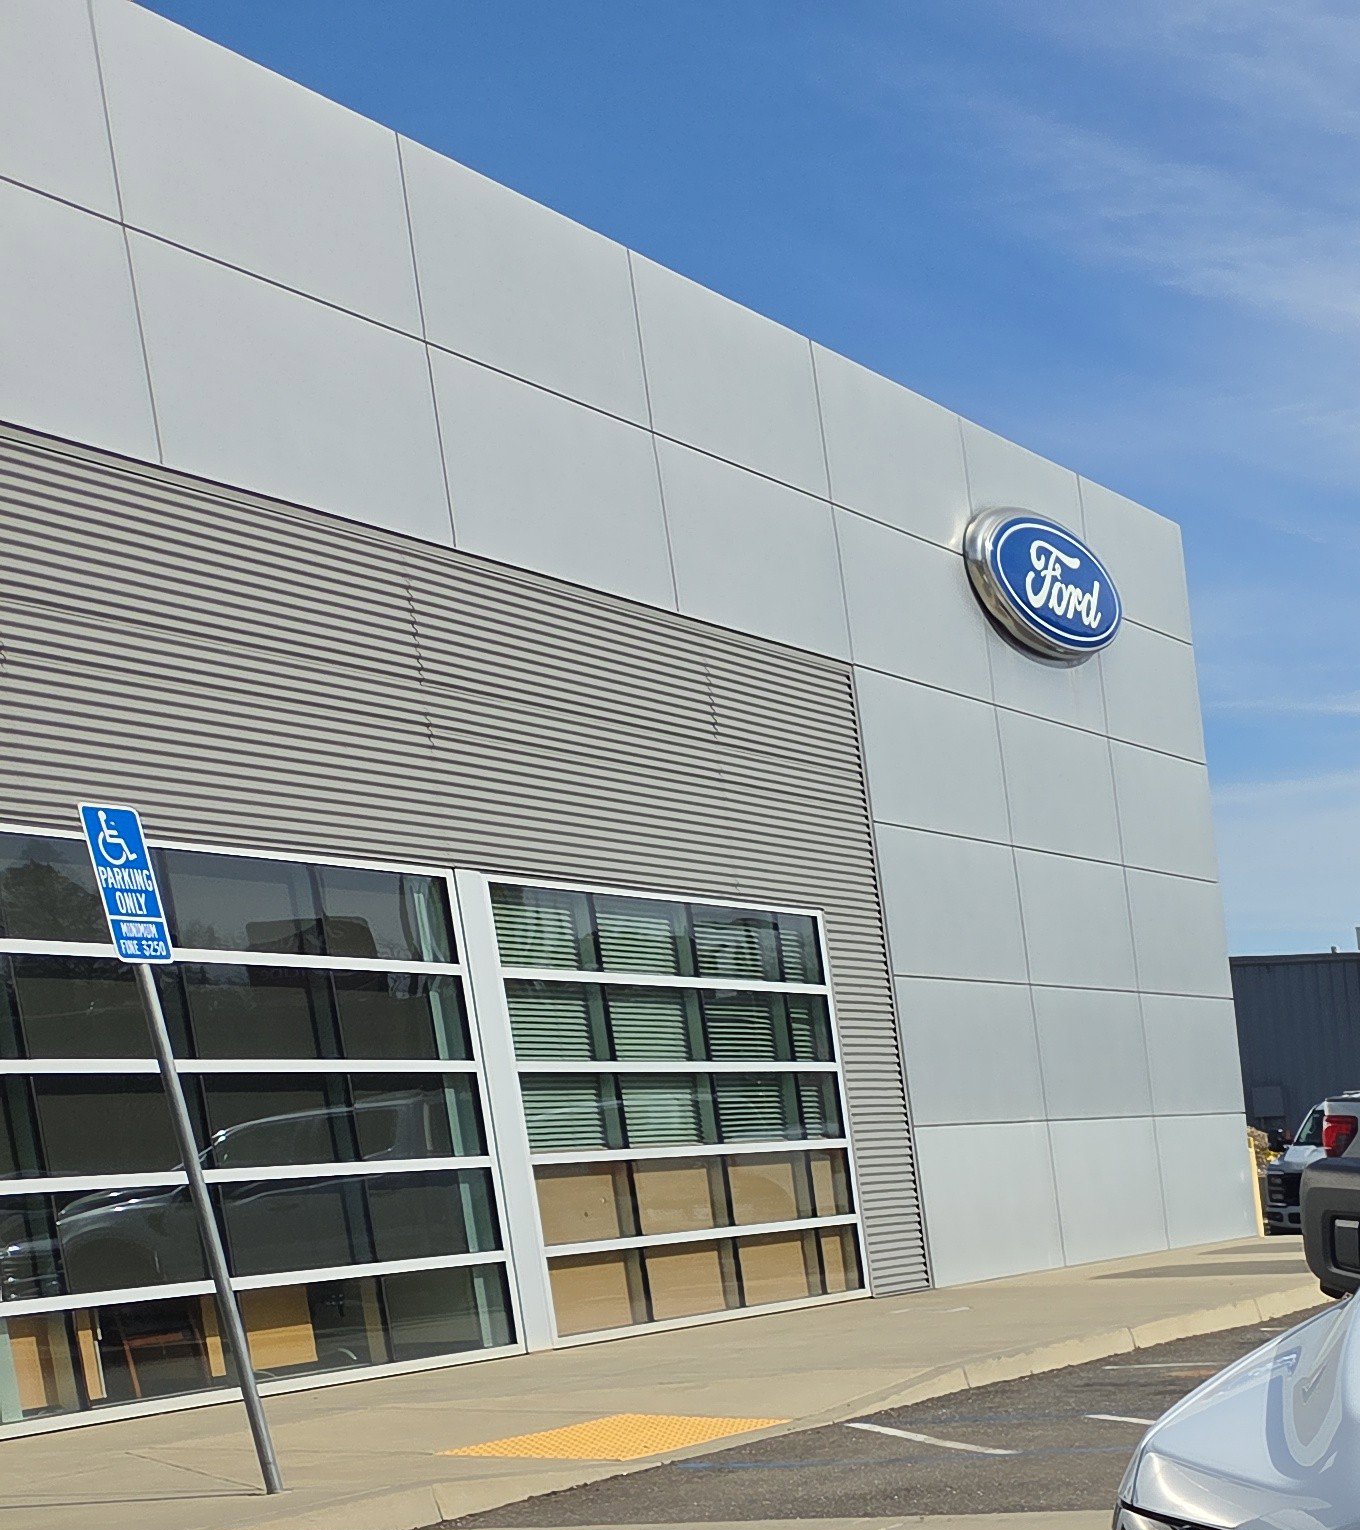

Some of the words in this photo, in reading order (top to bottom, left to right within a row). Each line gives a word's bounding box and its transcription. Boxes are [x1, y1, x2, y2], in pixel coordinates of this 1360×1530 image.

[1026, 540, 1102, 629] Ford
[98, 866, 153, 891] PARKING
[115, 891, 147, 914] ONLY
[120, 922, 158, 938] MINIMUM
[120, 940, 141, 954] FINE
[142, 940, 166, 956] $250
